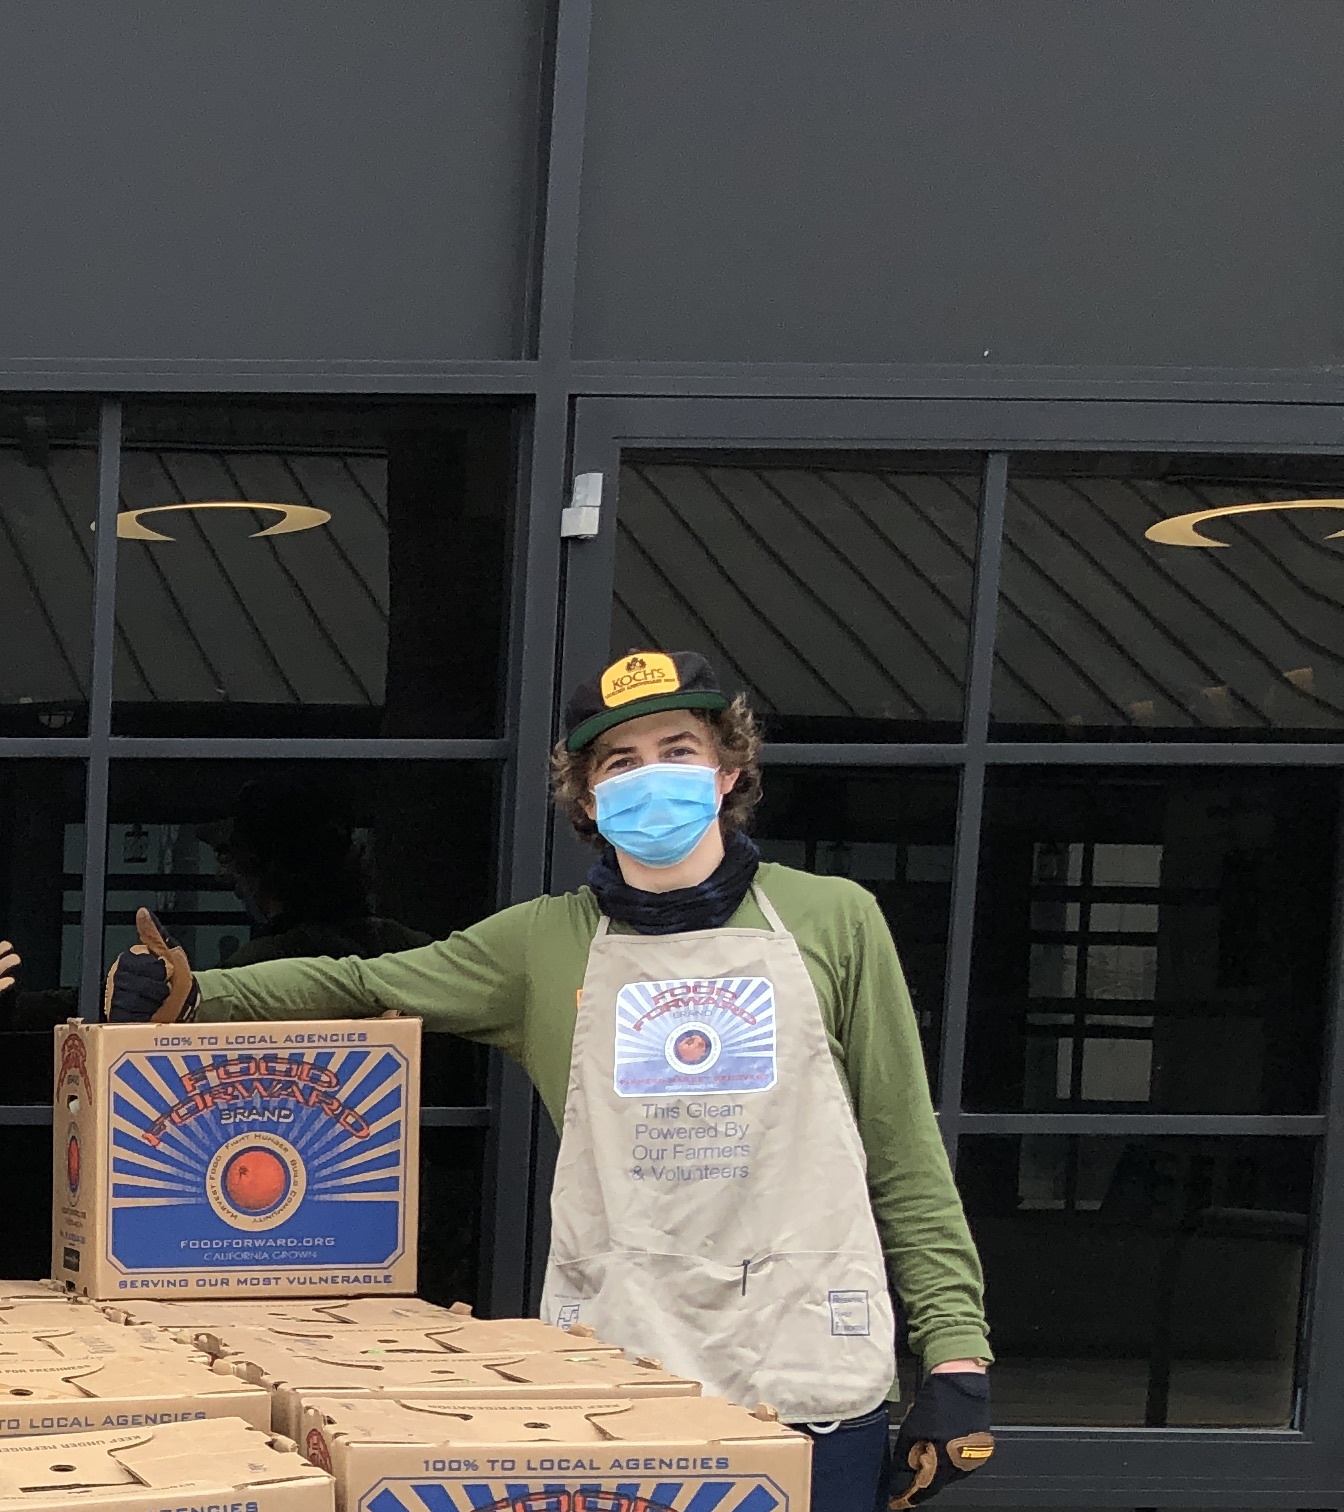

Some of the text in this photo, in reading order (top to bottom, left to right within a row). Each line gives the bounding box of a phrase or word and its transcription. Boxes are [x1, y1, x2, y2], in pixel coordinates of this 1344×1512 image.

[612, 668, 666, 690] KOCH'S
[652, 984, 738, 1006] FOOD
[632, 996, 756, 1032] FORWARD
[153, 1032, 367, 1046] 100% TO LOCAL AGENCIES
[179, 1058, 340, 1095] FOOD
[141, 1080, 371, 1148] FORWARD
[220, 1108, 295, 1124] BRAND
[642, 1101, 744, 1120] This Glean
[634, 1122, 750, 1141] Powered By
[632, 1142, 750, 1162] Our Farmers
[650, 1162, 750, 1182] Volunteers
[180, 1237, 335, 1250] FOODFORWARD.ORG
[29, 1416, 94, 1430] LOCAL
[102, 1412, 206, 1427] AGENCIES
